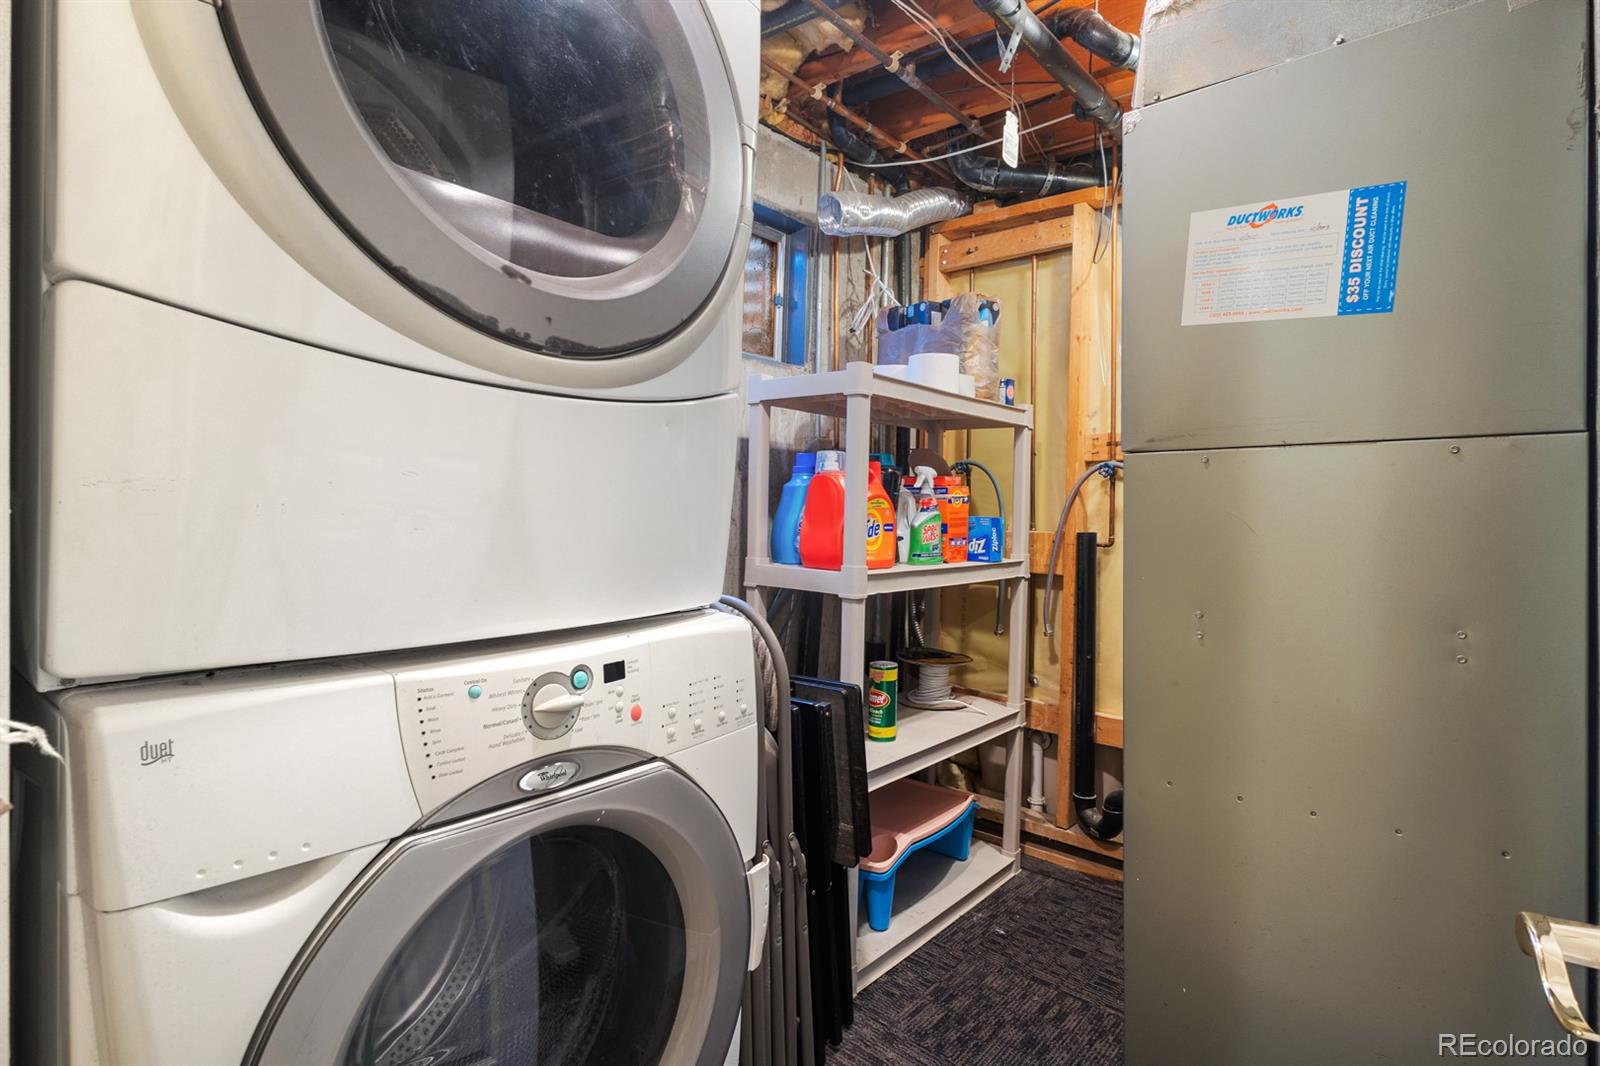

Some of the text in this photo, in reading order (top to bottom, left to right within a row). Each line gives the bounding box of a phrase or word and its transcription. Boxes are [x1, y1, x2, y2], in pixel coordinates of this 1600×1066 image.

[1227, 206, 1304, 226] DUCTWORKS
[1370, 196, 1379, 226] CLEANING
[1346, 197, 1370, 303] $35 DISCOUNT
[140, 739, 174, 761] duet
